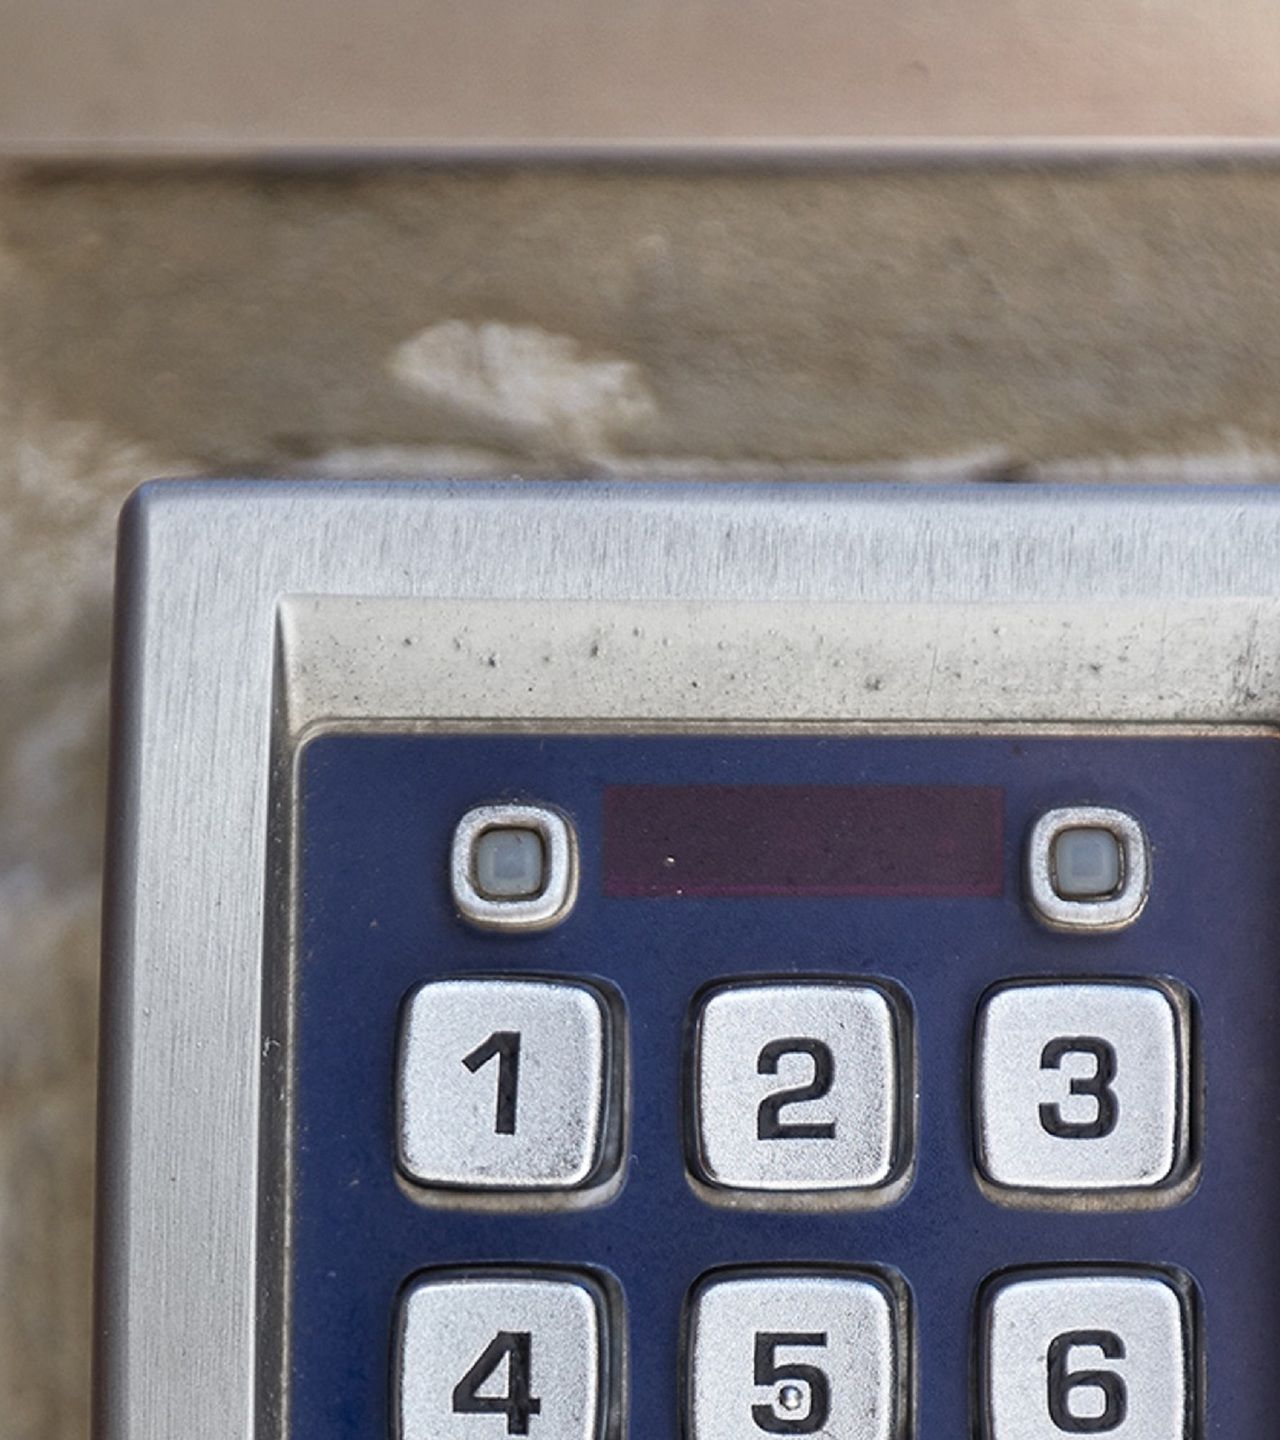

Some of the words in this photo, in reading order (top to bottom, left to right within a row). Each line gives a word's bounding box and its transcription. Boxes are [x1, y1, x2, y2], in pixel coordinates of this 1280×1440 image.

[462, 1032, 520, 1135] 1
[757, 1039, 835, 1140] 2
[1039, 1037, 1117, 1139] 3
[453, 1331, 540, 1435] 4
[752, 1332, 830, 1434] 5
[1047, 1330, 1126, 1433] 6
